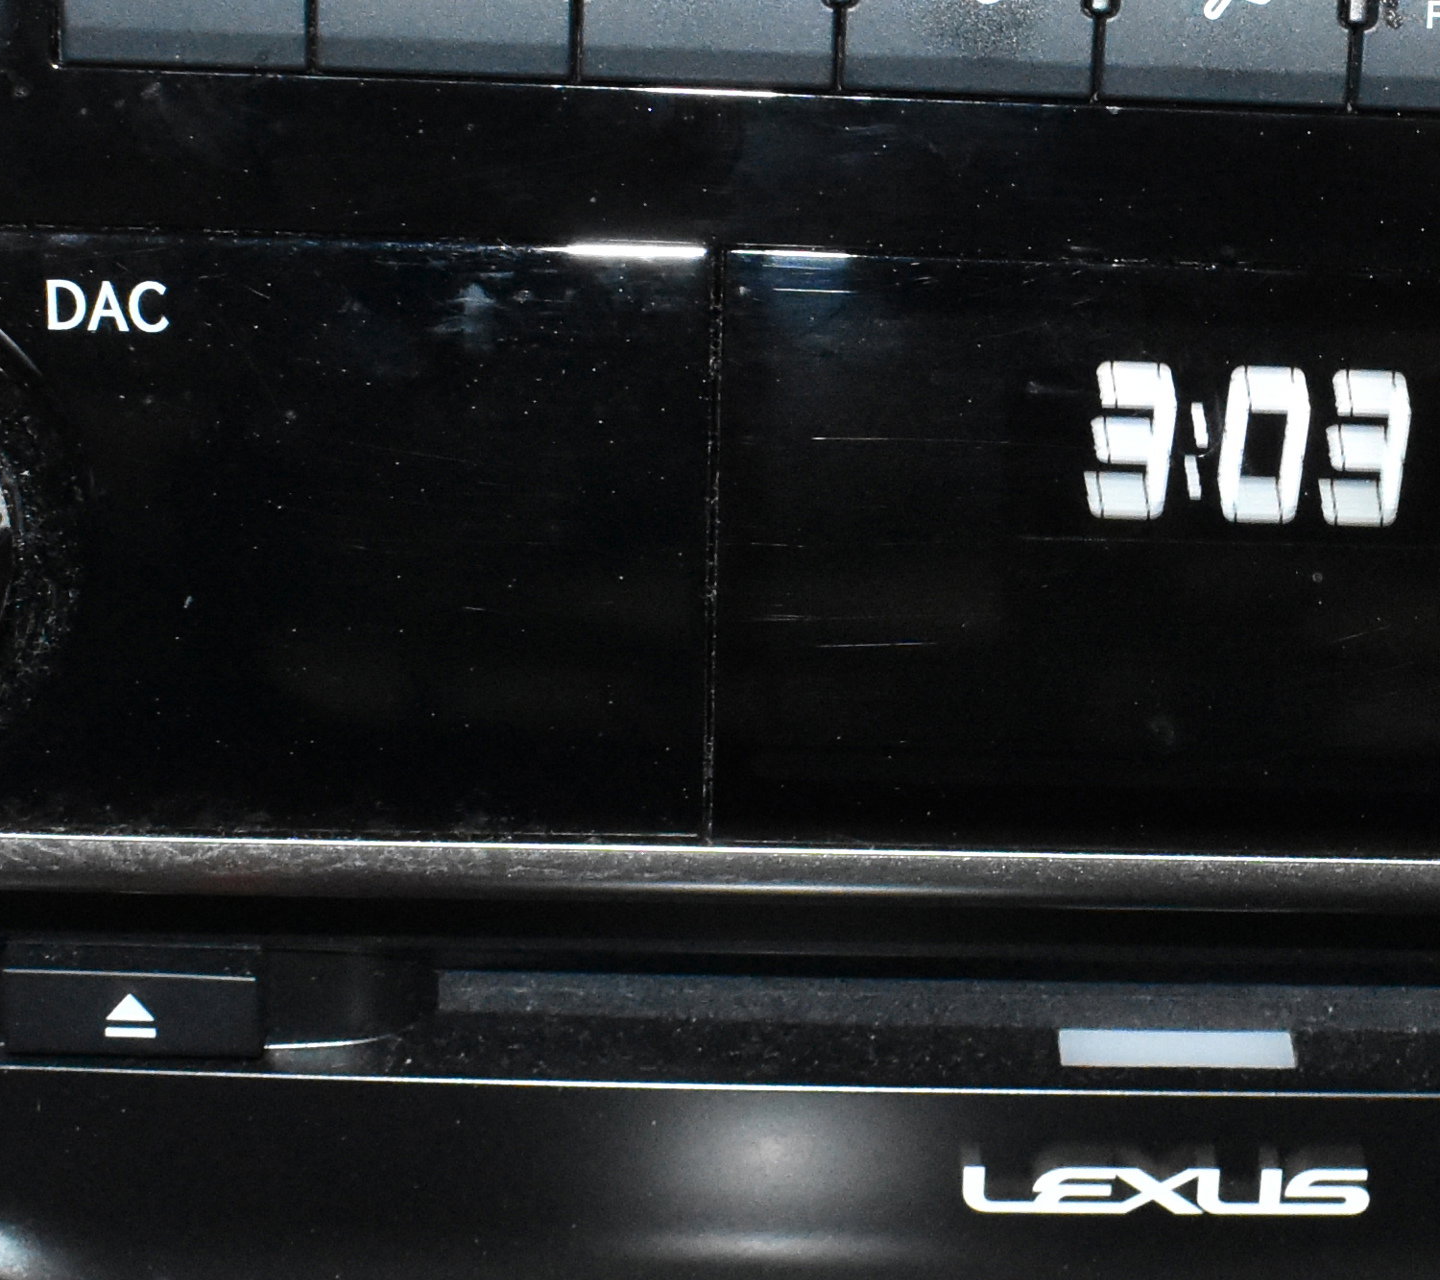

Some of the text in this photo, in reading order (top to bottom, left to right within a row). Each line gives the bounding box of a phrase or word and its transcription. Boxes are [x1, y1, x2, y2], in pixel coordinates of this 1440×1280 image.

[46, 279, 169, 332] DAC
[1084, 361, 1411, 525] 3:03
[962, 1165, 1370, 1215] LEXUS
